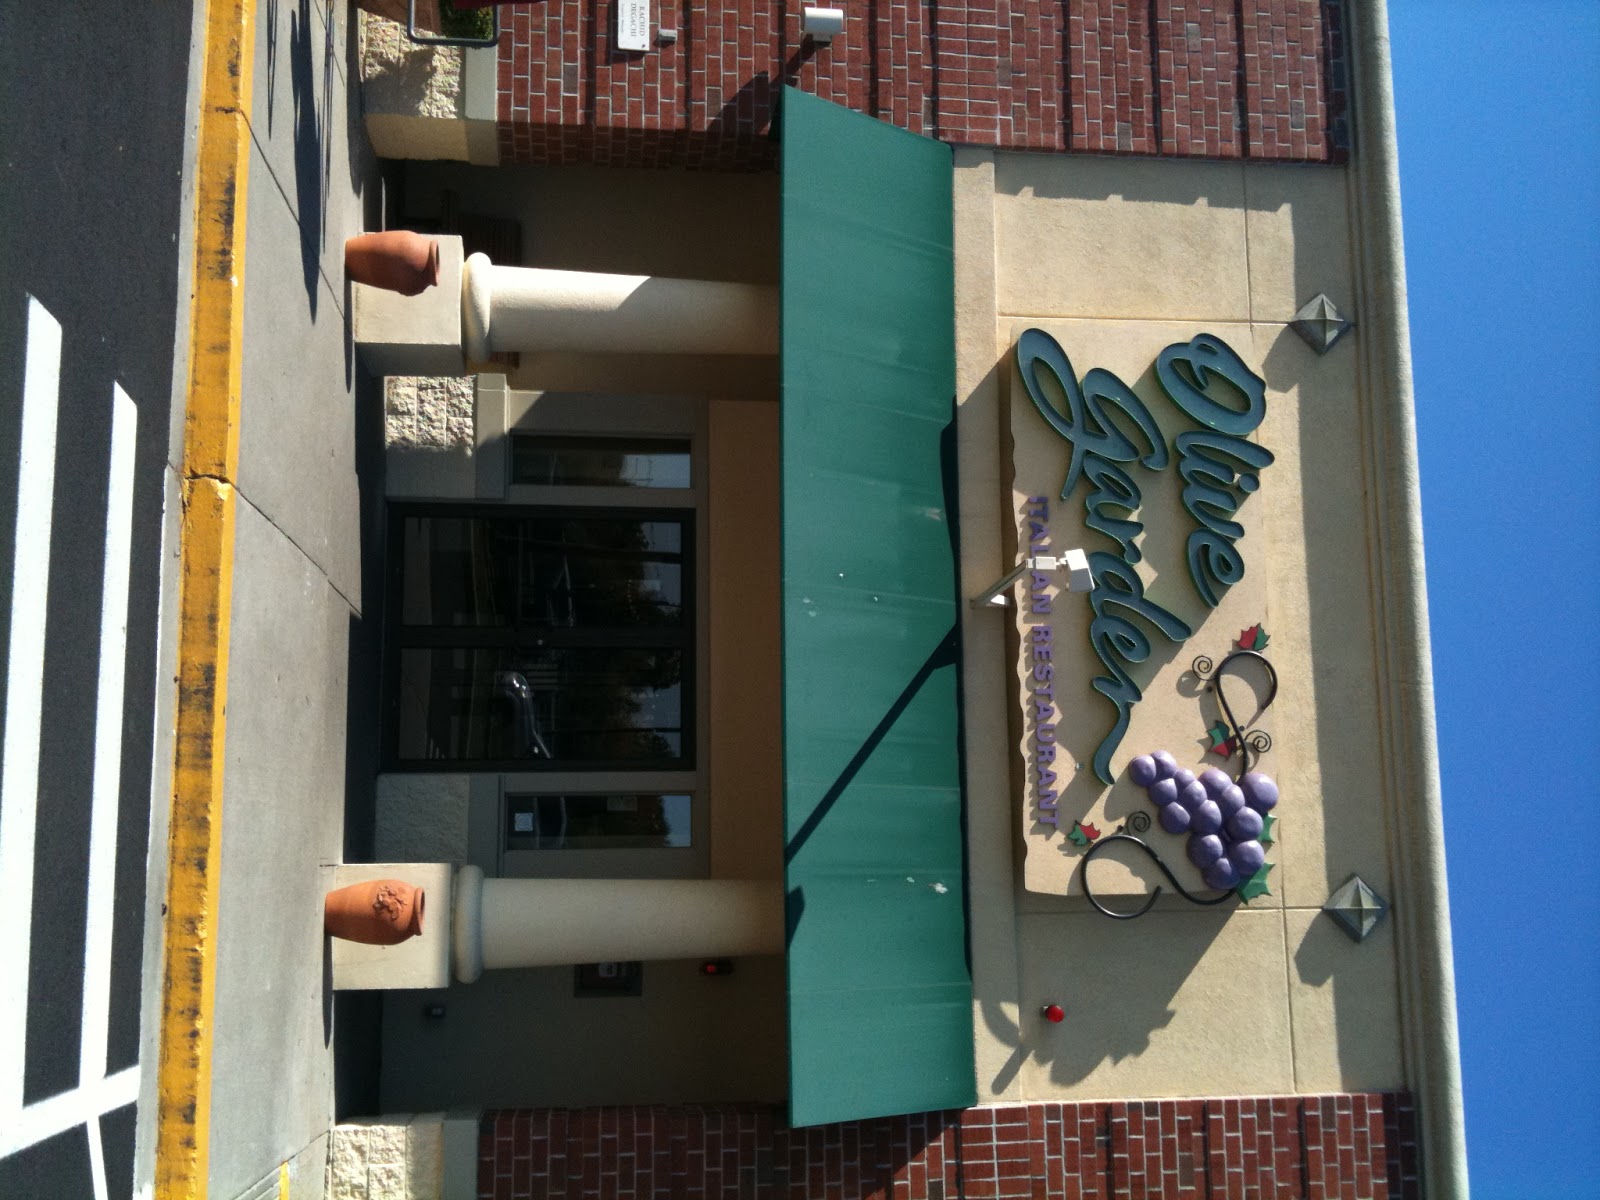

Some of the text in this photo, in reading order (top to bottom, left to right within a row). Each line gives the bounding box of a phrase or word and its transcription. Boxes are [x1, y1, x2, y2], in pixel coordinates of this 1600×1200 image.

[1016, 328, 1192, 786] Garden
[1153, 333, 1275, 608] Olive
[1028, 496, 1059, 830] ITALAN RESTAURANT
